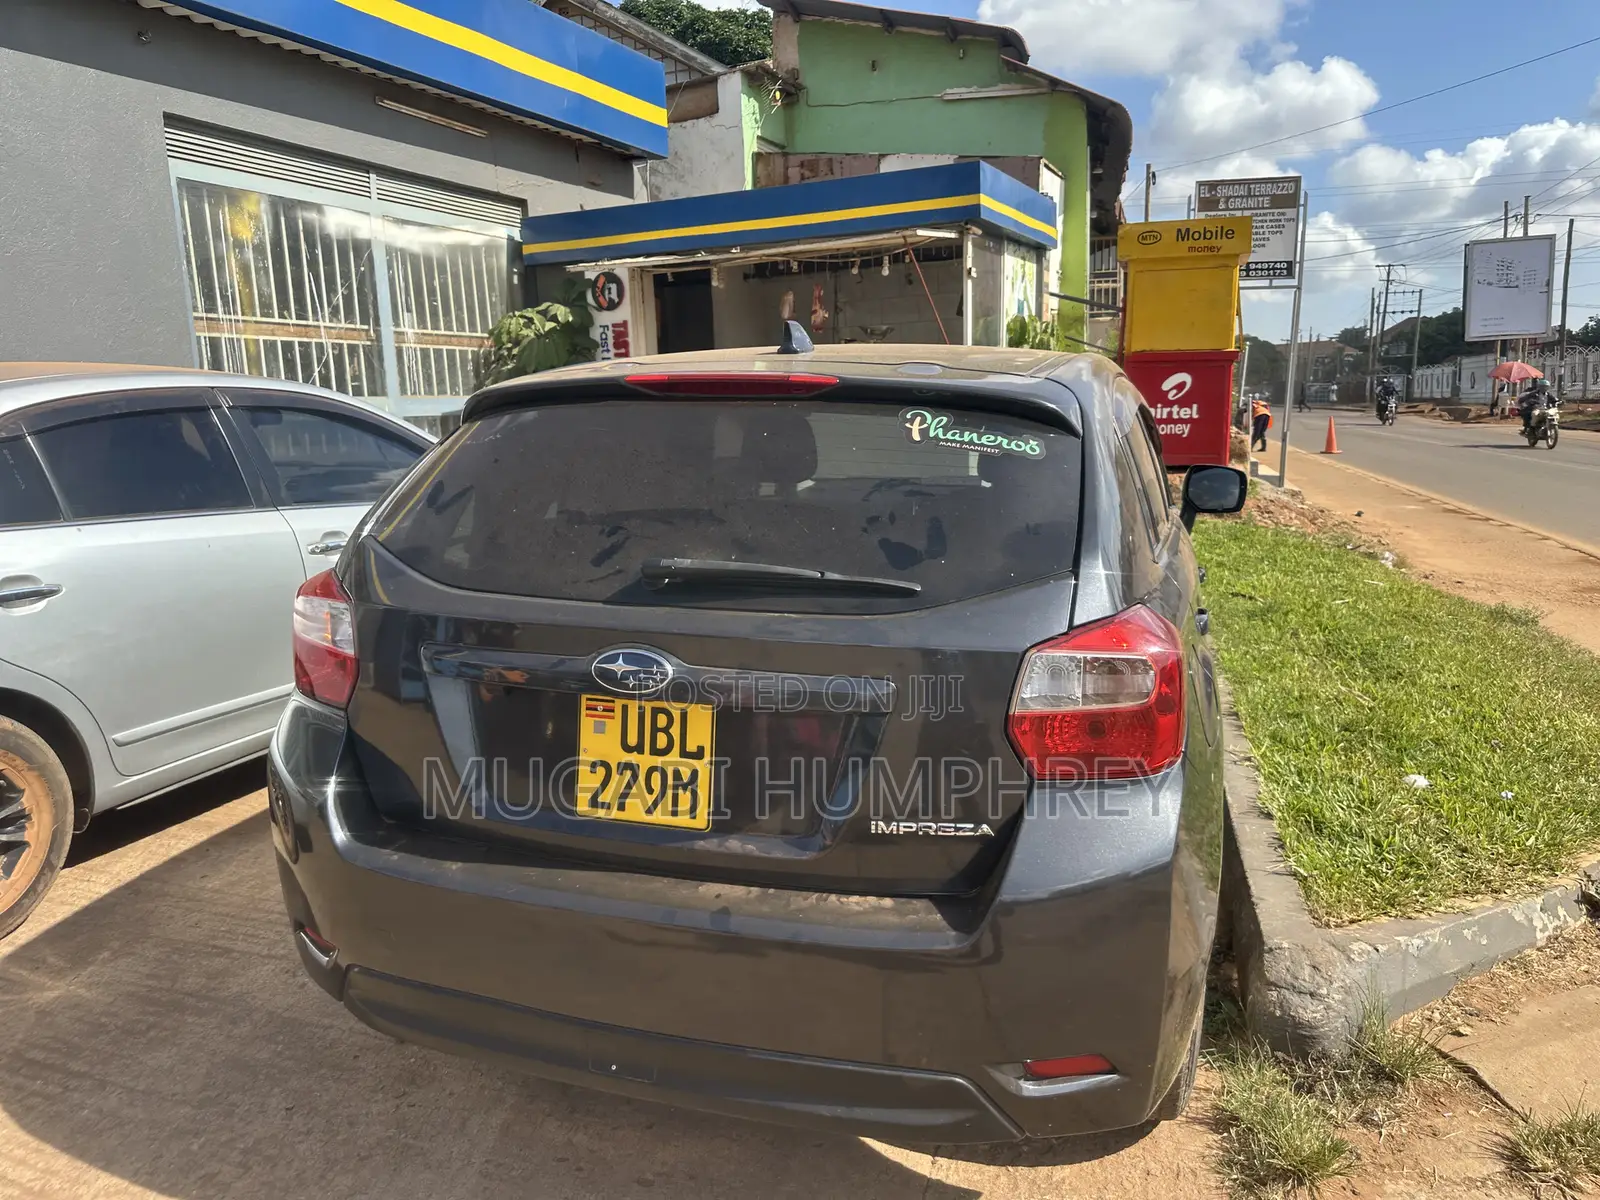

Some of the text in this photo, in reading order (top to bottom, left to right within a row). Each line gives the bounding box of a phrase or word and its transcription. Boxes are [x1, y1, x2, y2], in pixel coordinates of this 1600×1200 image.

[1200, 185, 1211, 197] EL
[1216, 184, 1248, 197] SHADAI
[1249, 182, 1296, 196] TERRAZZO
[1218, 197, 1271, 209] & GRANITE
[1140, 234, 1159, 242] MTN
[1176, 225, 1235, 242] Mobile
[1187, 244, 1223, 253] money
[1249, 269, 1288, 277] 030173
[599, 325, 611, 354] Fast
[1157, 423, 1192, 438] oney
[939, 441, 1000, 454] MAKE MANIFEST
[620, 703, 705, 761] UBL
[588, 759, 699, 820] 279M
[870, 820, 995, 837] IMPREZA
